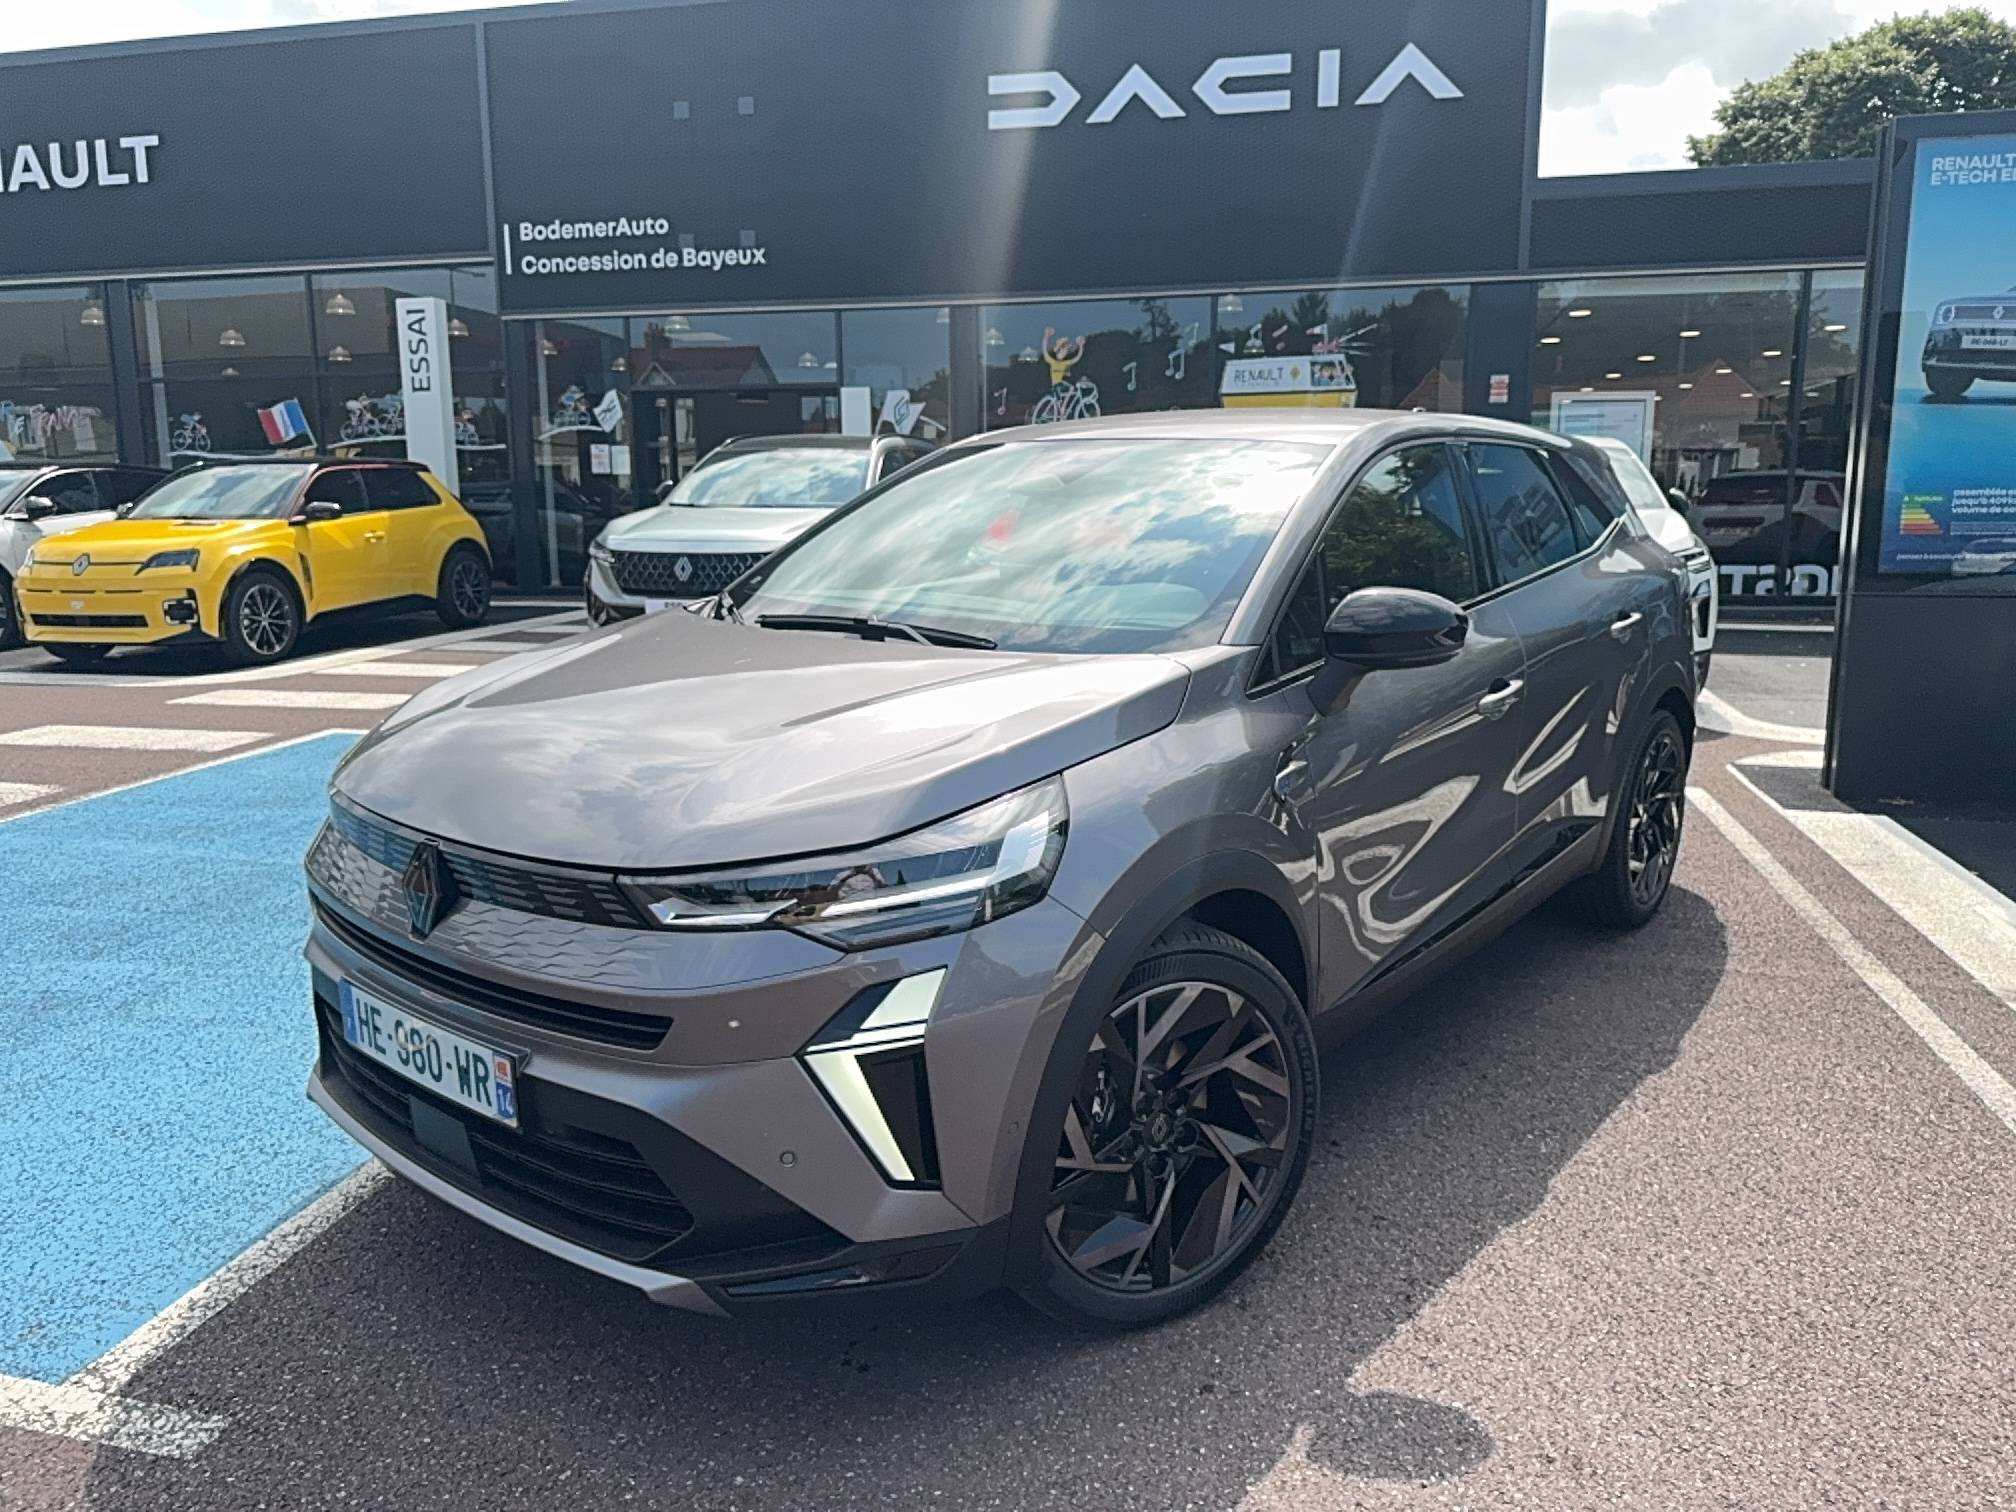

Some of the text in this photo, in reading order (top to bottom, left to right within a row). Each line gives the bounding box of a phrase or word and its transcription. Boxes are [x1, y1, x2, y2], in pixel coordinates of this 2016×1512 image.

[988, 42, 1465, 130] DACIA
[0, 134, 159, 193] AULT
[1932, 153, 2016, 171] RENAULT
[1931, 169, 1997, 185] E-TECH
[519, 217, 669, 241] BodemerAuto
[521, 247, 767, 274] Concession de Bayeux
[406, 309, 431, 393] ESSAI
[1233, 367, 1285, 383] RENAULT
[1951, 506, 1988, 514] volume
[1989, 505, 2002, 514] de
[356, 998, 492, 1107] HE-980-WR
[1297, 1034, 1315, 1130] MICHELIN
